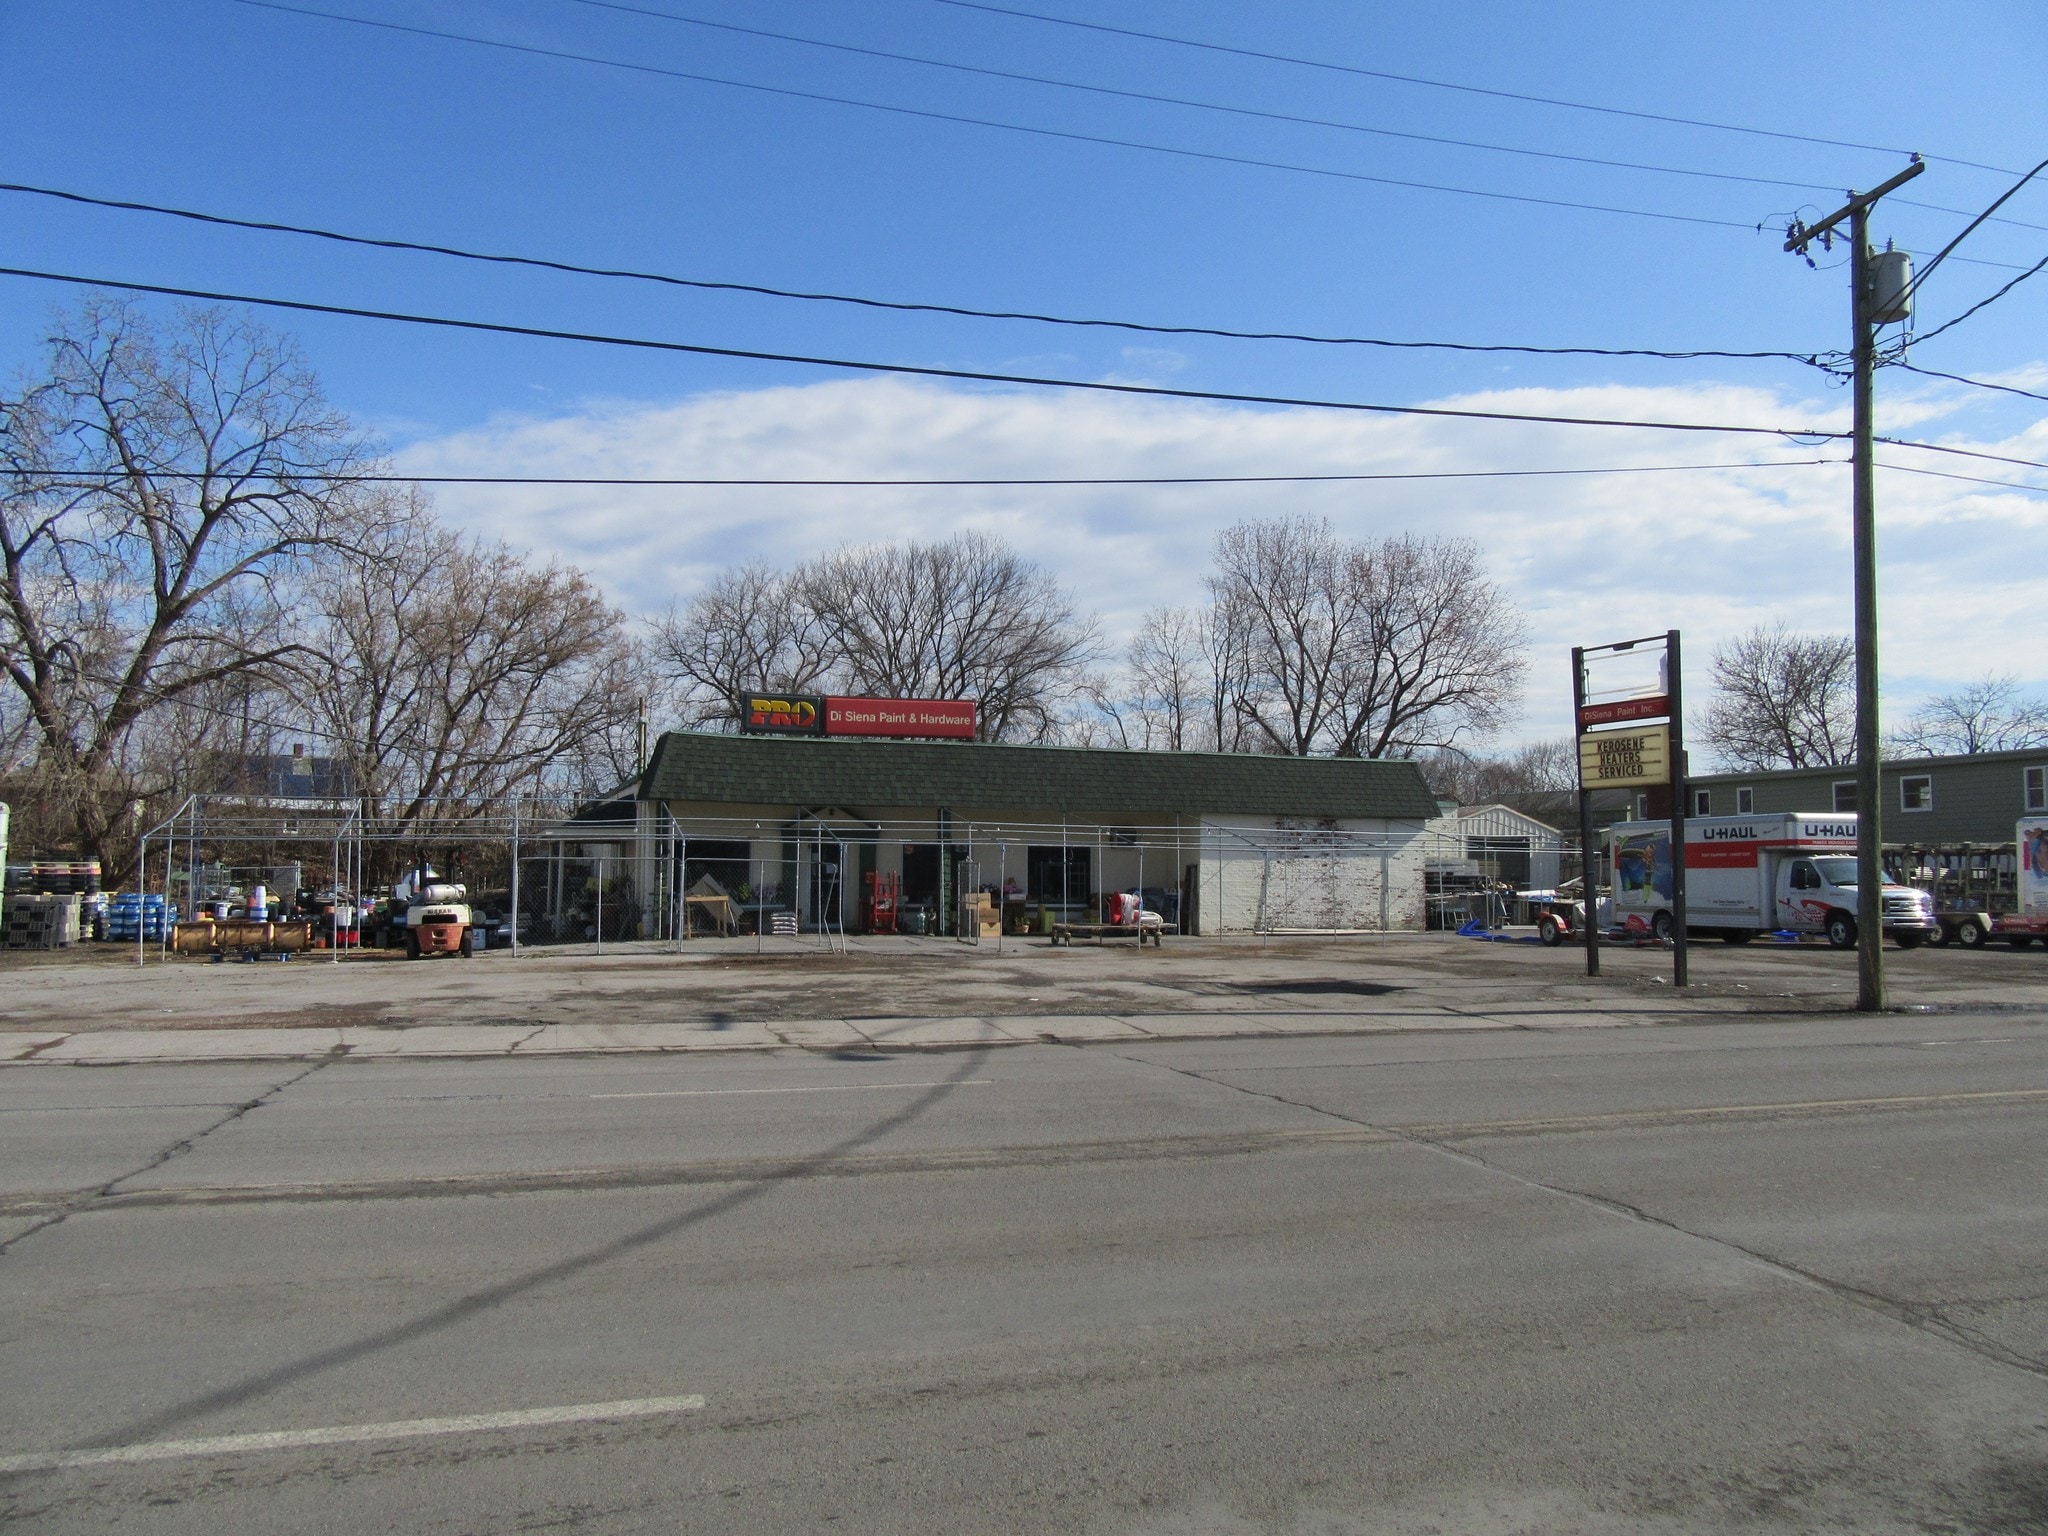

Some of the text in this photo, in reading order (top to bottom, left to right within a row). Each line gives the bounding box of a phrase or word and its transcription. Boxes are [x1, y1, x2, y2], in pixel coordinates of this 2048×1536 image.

[751, 700, 815, 726] PRO
[1617, 707, 1636, 716] Paint
[1641, 704, 1655, 712] Inc.
[830, 711, 970, 725] Di Siena Paint & Hardware
[1597, 738, 1644, 752] KEROSENE
[1601, 752, 1640, 765] HEATERS
[1599, 765, 1643, 778] SERVICED
[1704, 827, 1757, 839] U-HAUL
[1805, 825, 1856, 836] U-HAU
